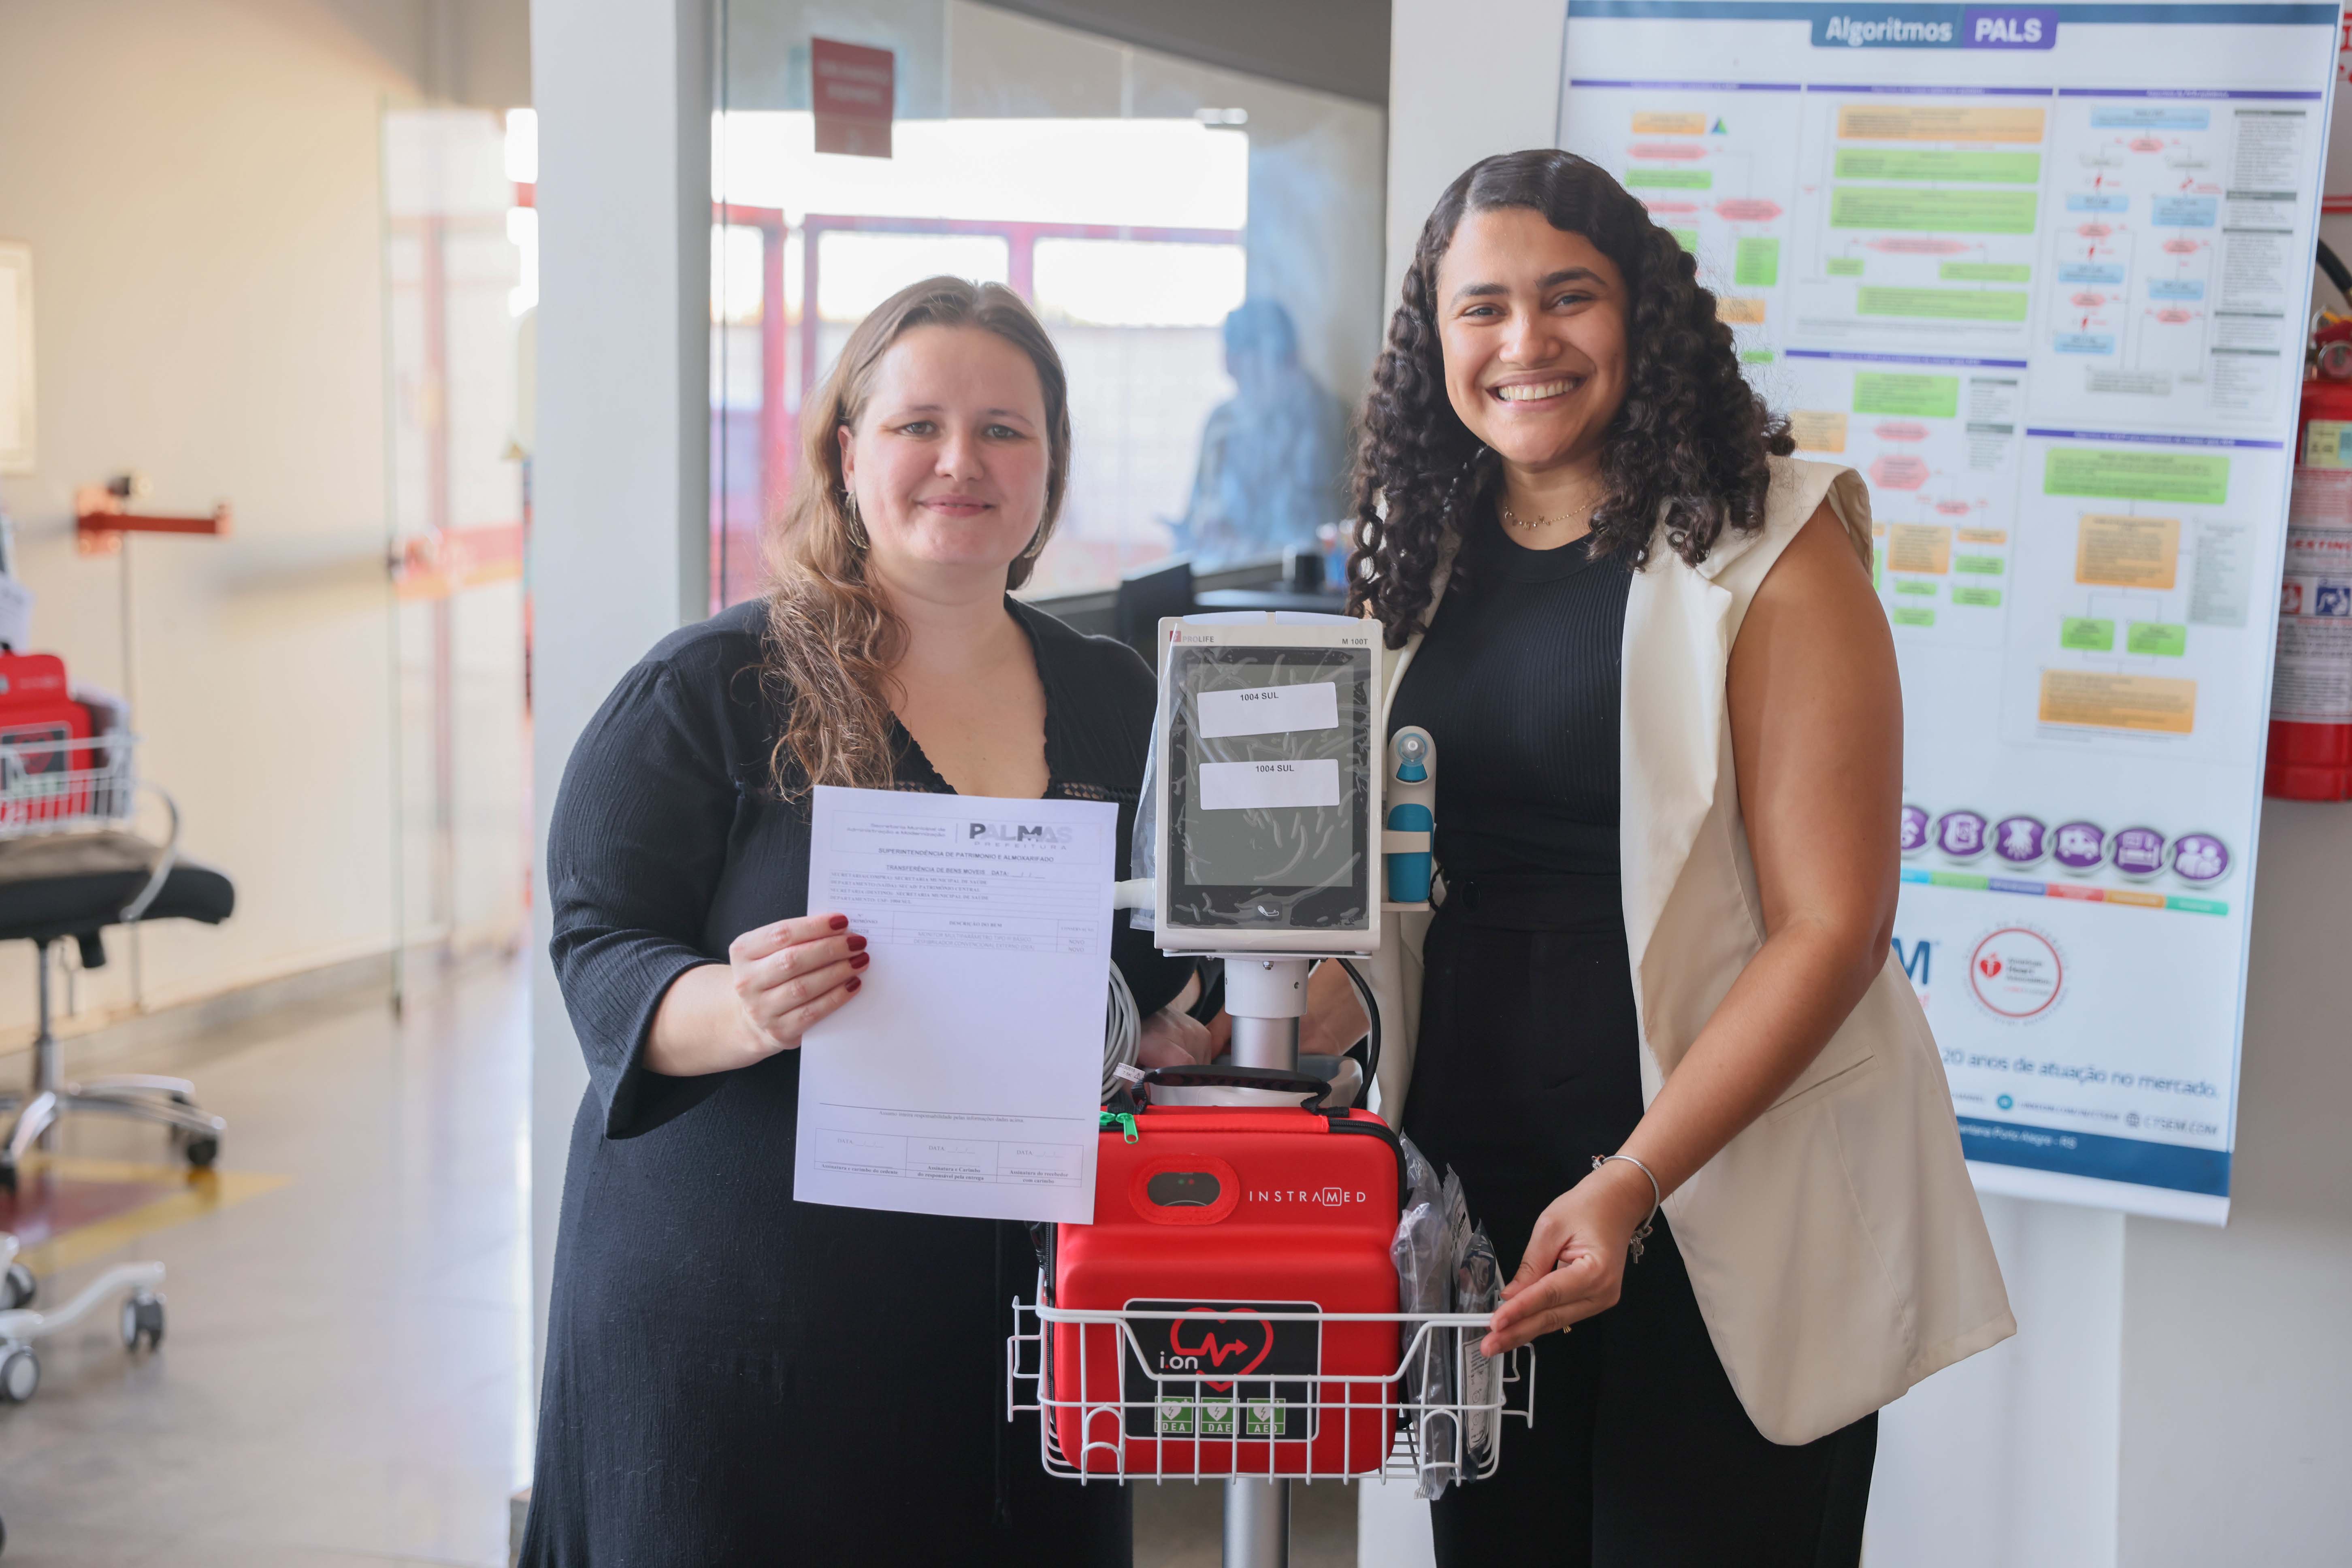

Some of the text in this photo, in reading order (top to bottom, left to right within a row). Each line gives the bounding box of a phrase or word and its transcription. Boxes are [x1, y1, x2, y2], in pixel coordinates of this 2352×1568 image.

[1825, 16, 2042, 47] Algoritmos PALS
[1277, 764, 1295, 772] SUL
[969, 822, 1073, 844] PALMAS
[974, 841, 1067, 850] PREFEITURA
[878, 848, 944, 857] SUPERINTENDÊNCIA
[886, 864, 935, 872] TRANSFERÊNCIA
[1968, 1055, 2007, 1071] anos
[2013, 1057, 2034, 1074] de
[2039, 1059, 2105, 1085] atuação
[2111, 1073, 2133, 1087] no
[1249, 1190, 1366, 1204] INSTRAMED
[1160, 1351, 1198, 1370] i.on
[1163, 1422, 1186, 1432] DEA
[1208, 1423, 1231, 1432] DAE
